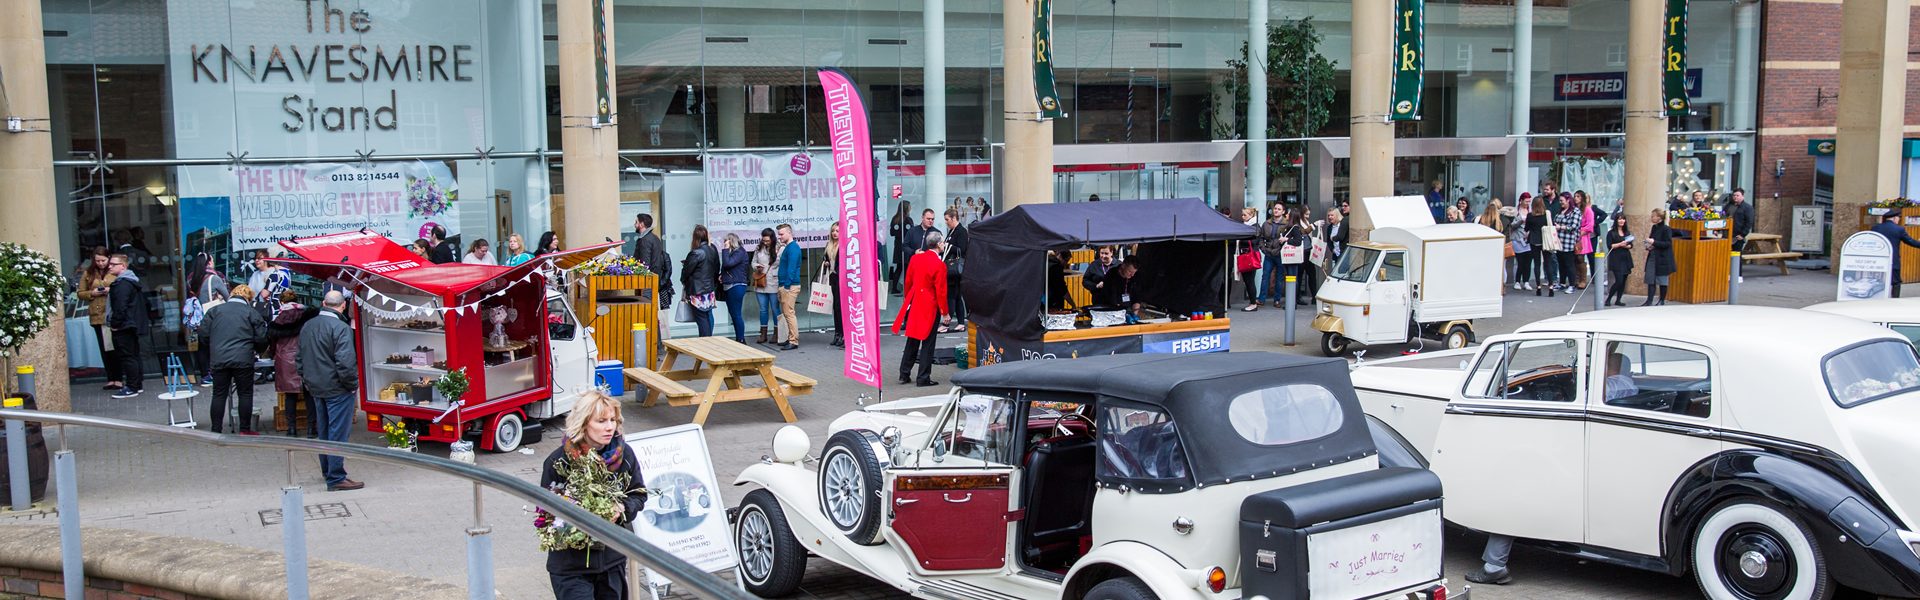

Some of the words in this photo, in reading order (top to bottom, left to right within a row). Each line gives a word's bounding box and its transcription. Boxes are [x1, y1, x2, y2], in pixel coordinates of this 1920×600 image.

[304, 0, 372, 33] The
[191, 43, 473, 84] KNAVESMIRE
[1562, 78, 1624, 94] BETFRED
[282, 89, 398, 133] Stand
[331, 174, 354, 182] 0113
[357, 172, 400, 181] 8214544
[709, 158, 737, 179] THE
[742, 158, 764, 179] UK
[235, 169, 274, 193] THE
[279, 168, 307, 192] UK
[709, 179, 787, 203] WEDDING
[789, 177, 838, 200] EVENT
[237, 193, 338, 220] WEDDING
[341, 191, 401, 216] EVENT
[709, 207, 725, 215] Call:
[726, 205, 749, 215] 0113
[750, 204, 794, 214] 8214544
[264, 219, 390, 232] sales@theukweddingevent.co.uk
[1800, 218, 1816, 226] York
[1172, 335, 1222, 354] FRESH
[1348, 556, 1367, 574] Just
[1370, 549, 1405, 562] Married
